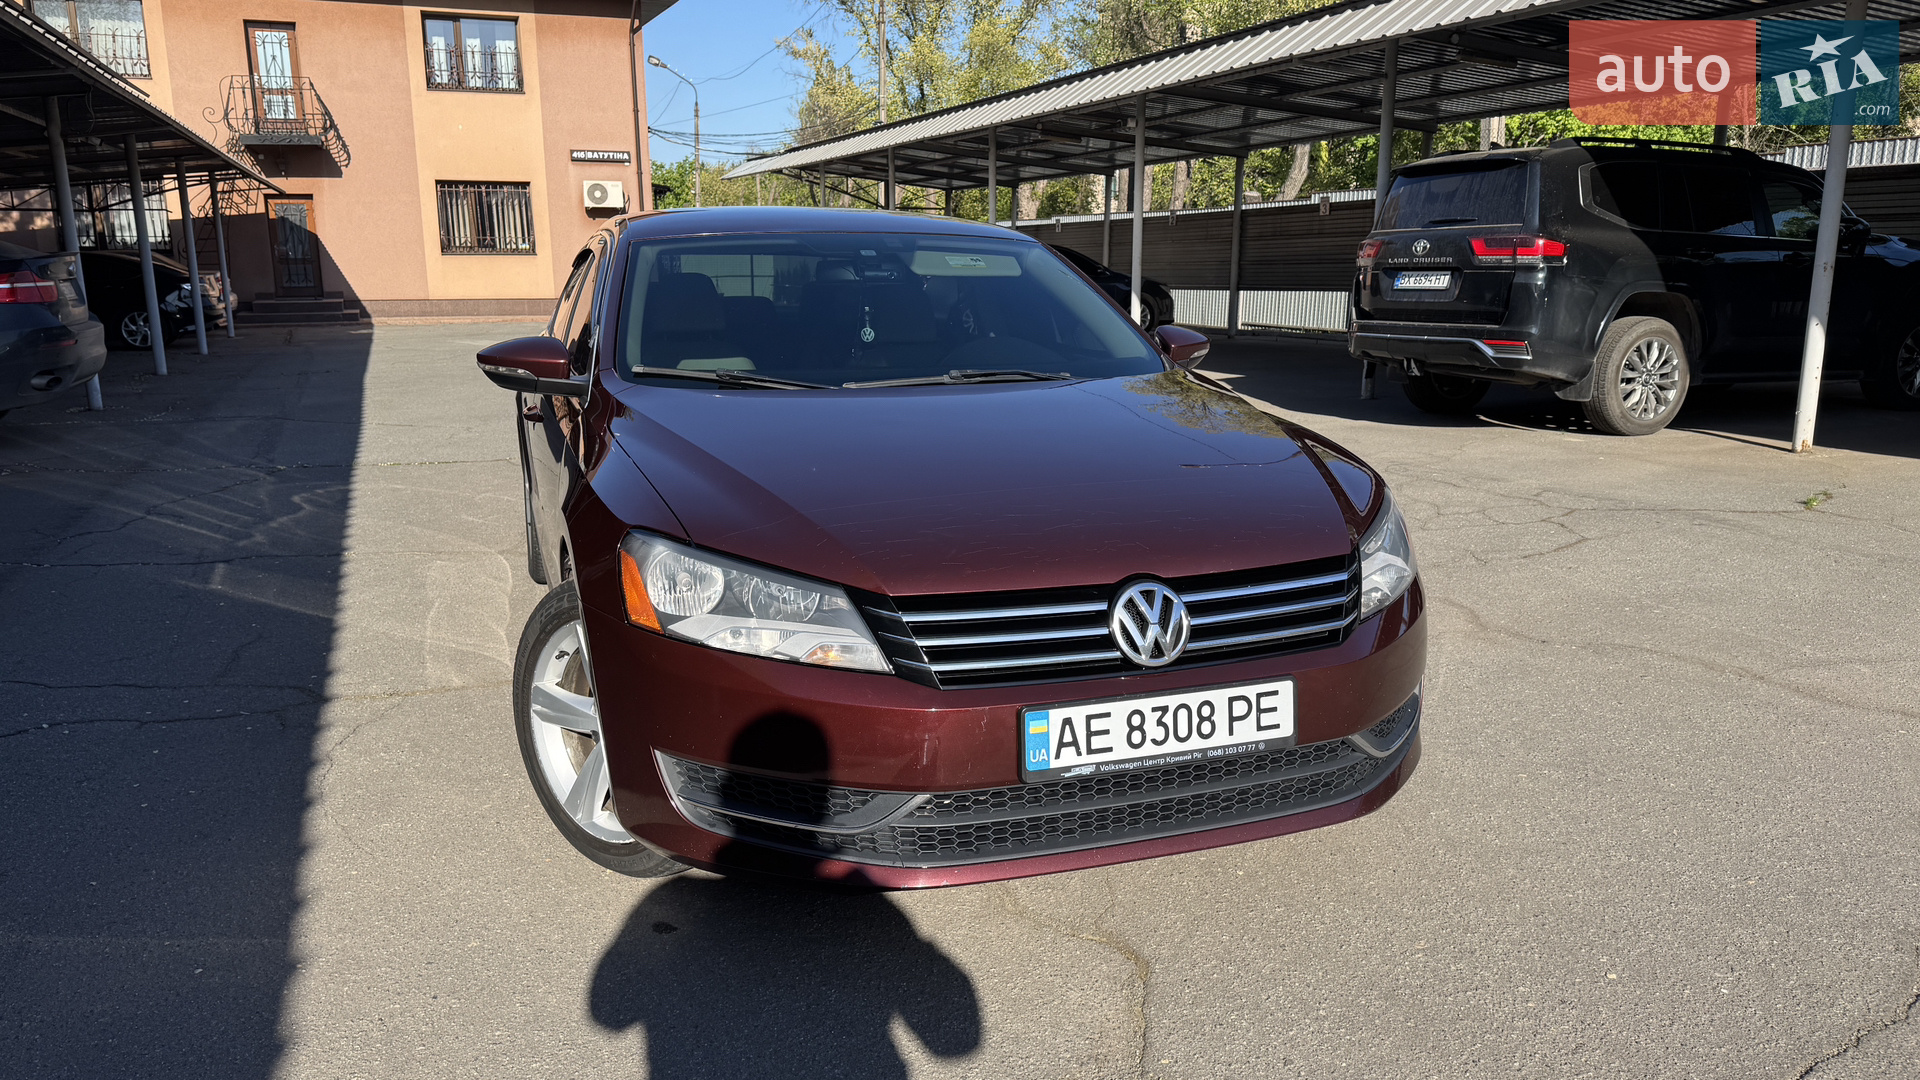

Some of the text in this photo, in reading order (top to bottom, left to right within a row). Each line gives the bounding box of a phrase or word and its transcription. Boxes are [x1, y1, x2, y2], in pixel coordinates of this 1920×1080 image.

[587, 151, 629, 160] ВАТУТІНА
[1322, 203, 1328, 215] 3
[1413, 273, 1432, 285] 6694
[1054, 689, 1281, 760] AE 8308 PE
[1029, 749, 1049, 763] UA
[1207, 748, 1224, 758] (068)
[1225, 746, 1237, 755] 103
[1238, 745, 1247, 753] 07
[1099, 760, 1142, 772] Volkswagen
[1143, 757, 1165, 767] Центр
[1166, 754, 1192, 764] Кривий
[1193, 752, 1203, 760] Ріг
